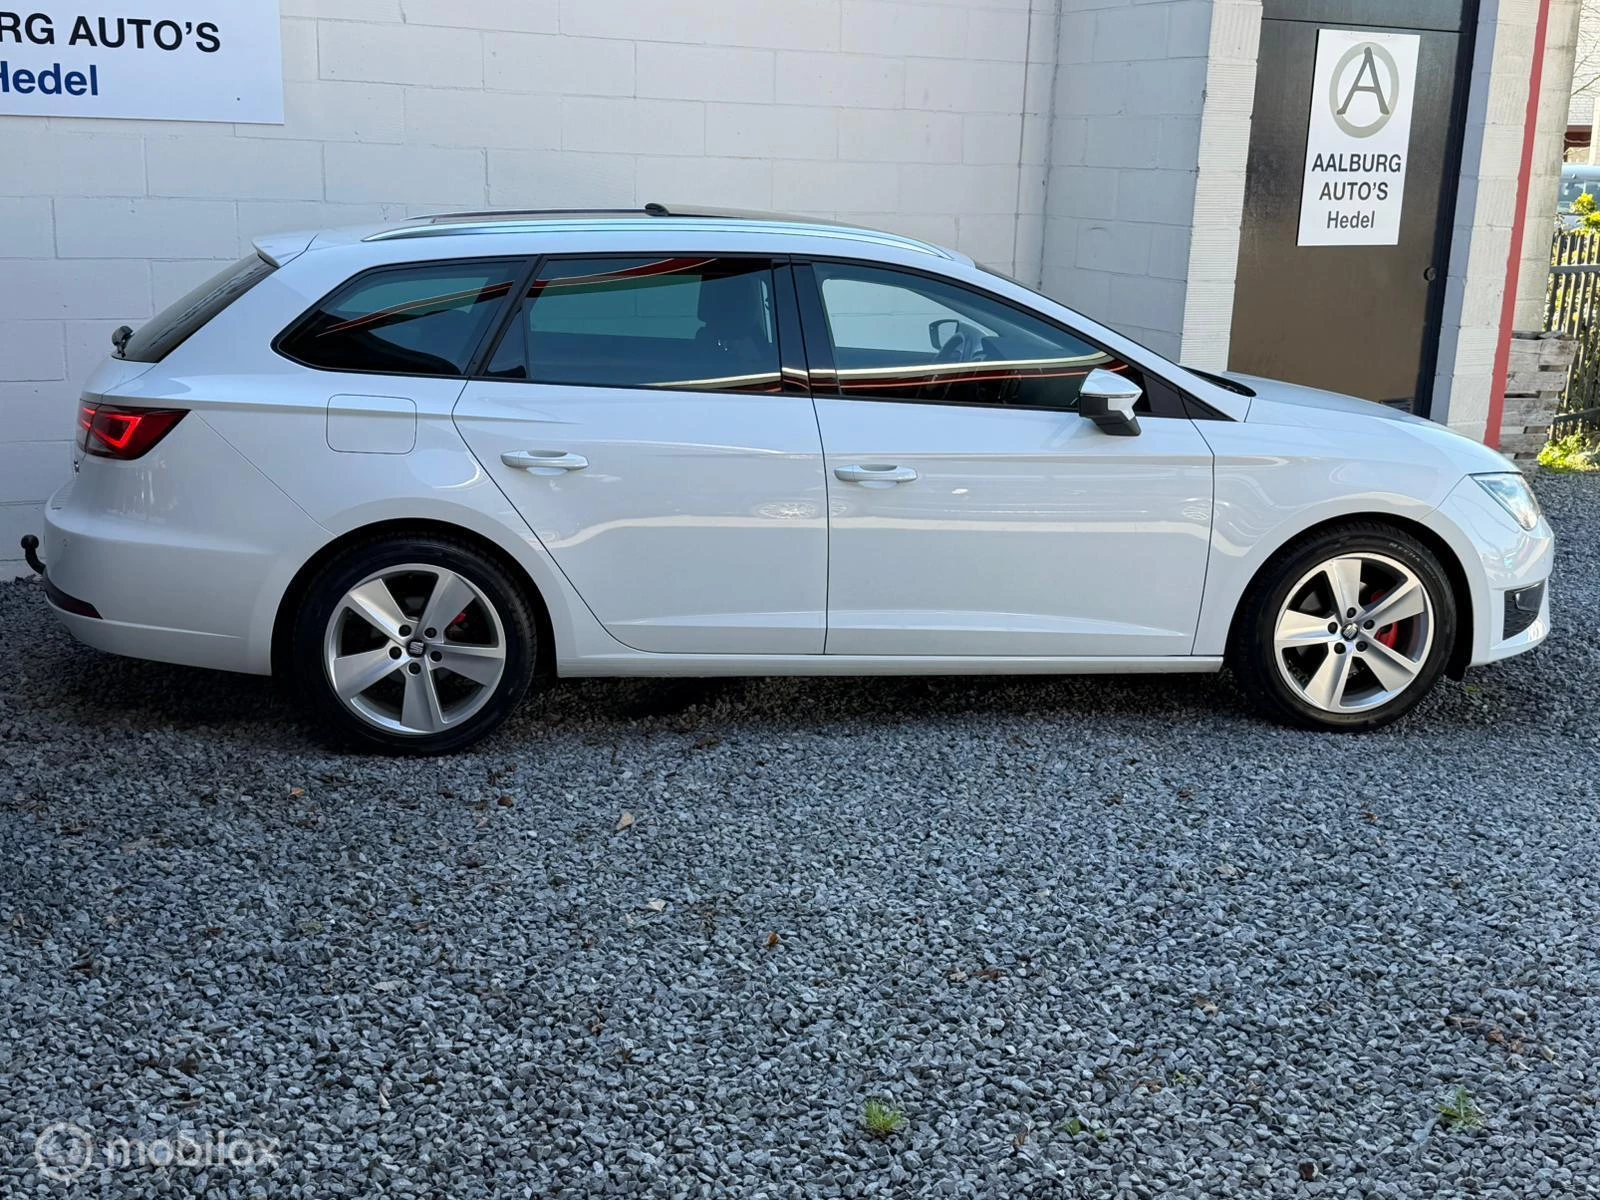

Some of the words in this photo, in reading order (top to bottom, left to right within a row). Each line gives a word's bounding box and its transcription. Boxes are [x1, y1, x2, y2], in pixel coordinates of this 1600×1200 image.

[68, 16, 221, 53] AUTO'S
[1311, 153, 1402, 172] AALBURG
[1319, 181, 1389, 201] AUTO'S
[1326, 210, 1376, 229] Hedel
